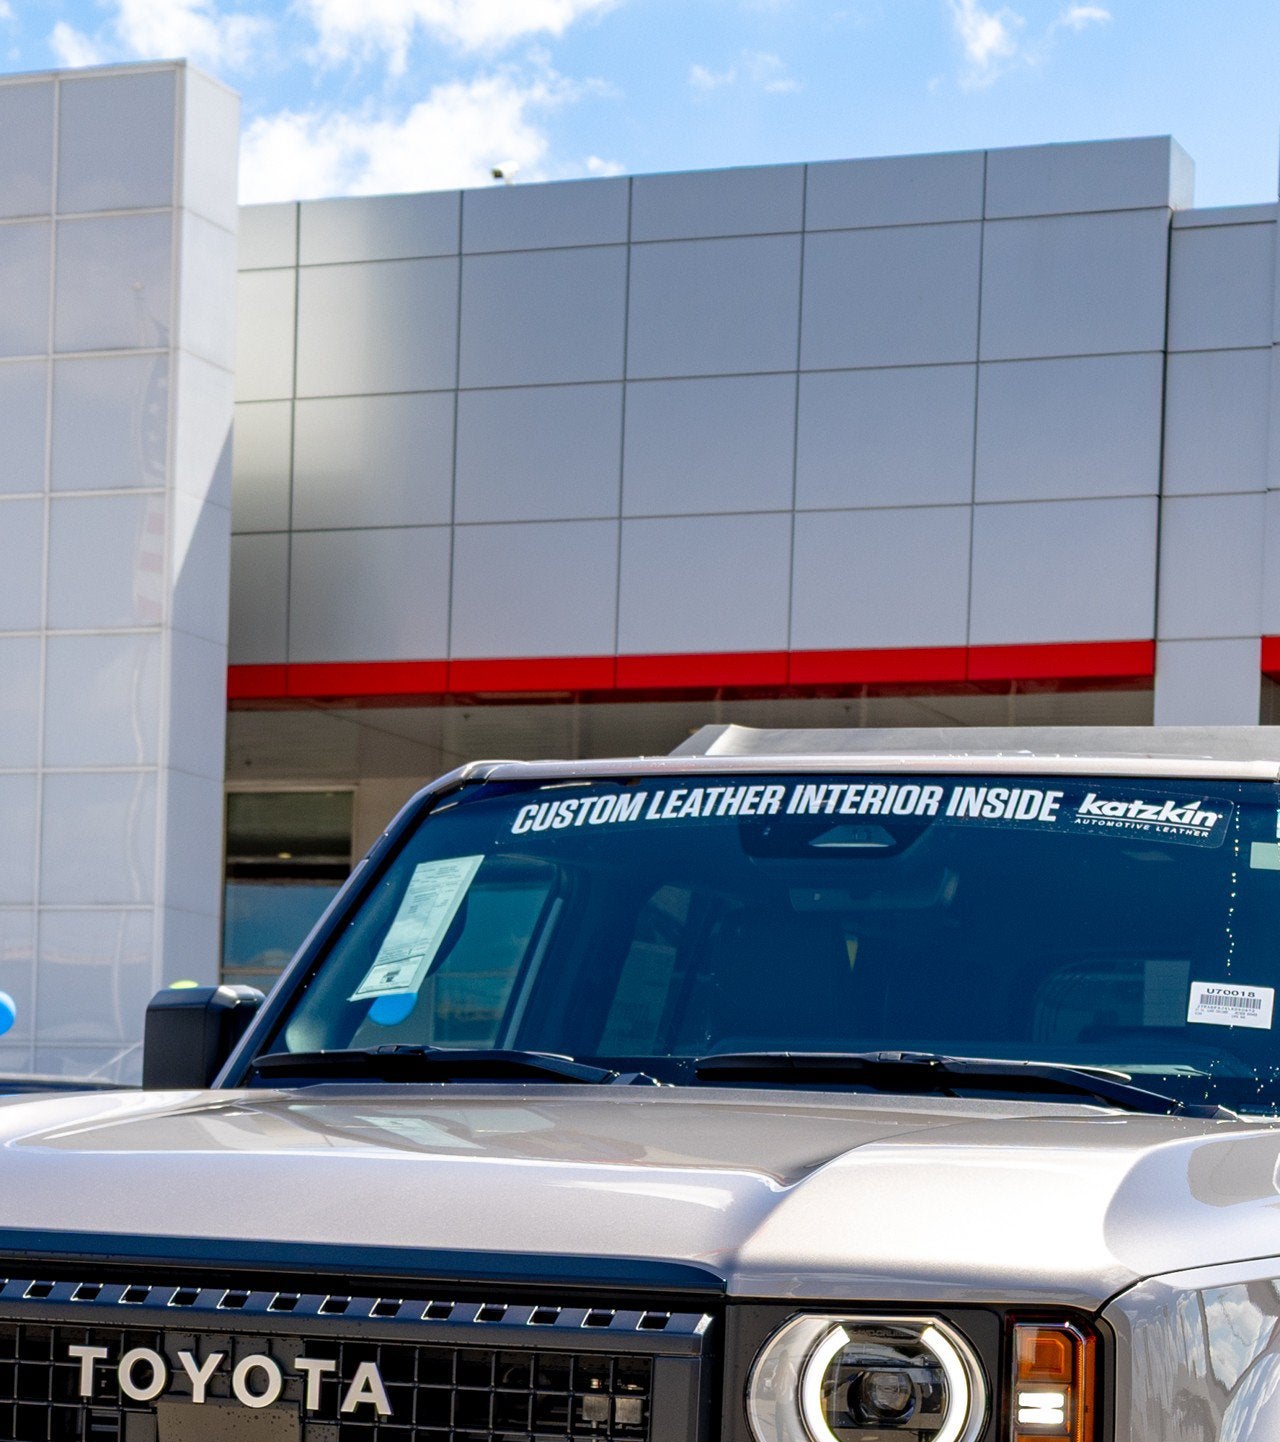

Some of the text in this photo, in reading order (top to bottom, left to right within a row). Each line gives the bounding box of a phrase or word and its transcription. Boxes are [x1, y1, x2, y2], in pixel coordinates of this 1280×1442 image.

[511, 784, 1064, 834] CUSTOM LEATHER INTERIOR INSIDE
[1077, 793, 1220, 827] katzkin
[1074, 817, 1209, 838] AUTOMOTIVE LEATHER
[1206, 988, 1256, 998] U70018
[69, 1345, 393, 1415] TOYOTA
